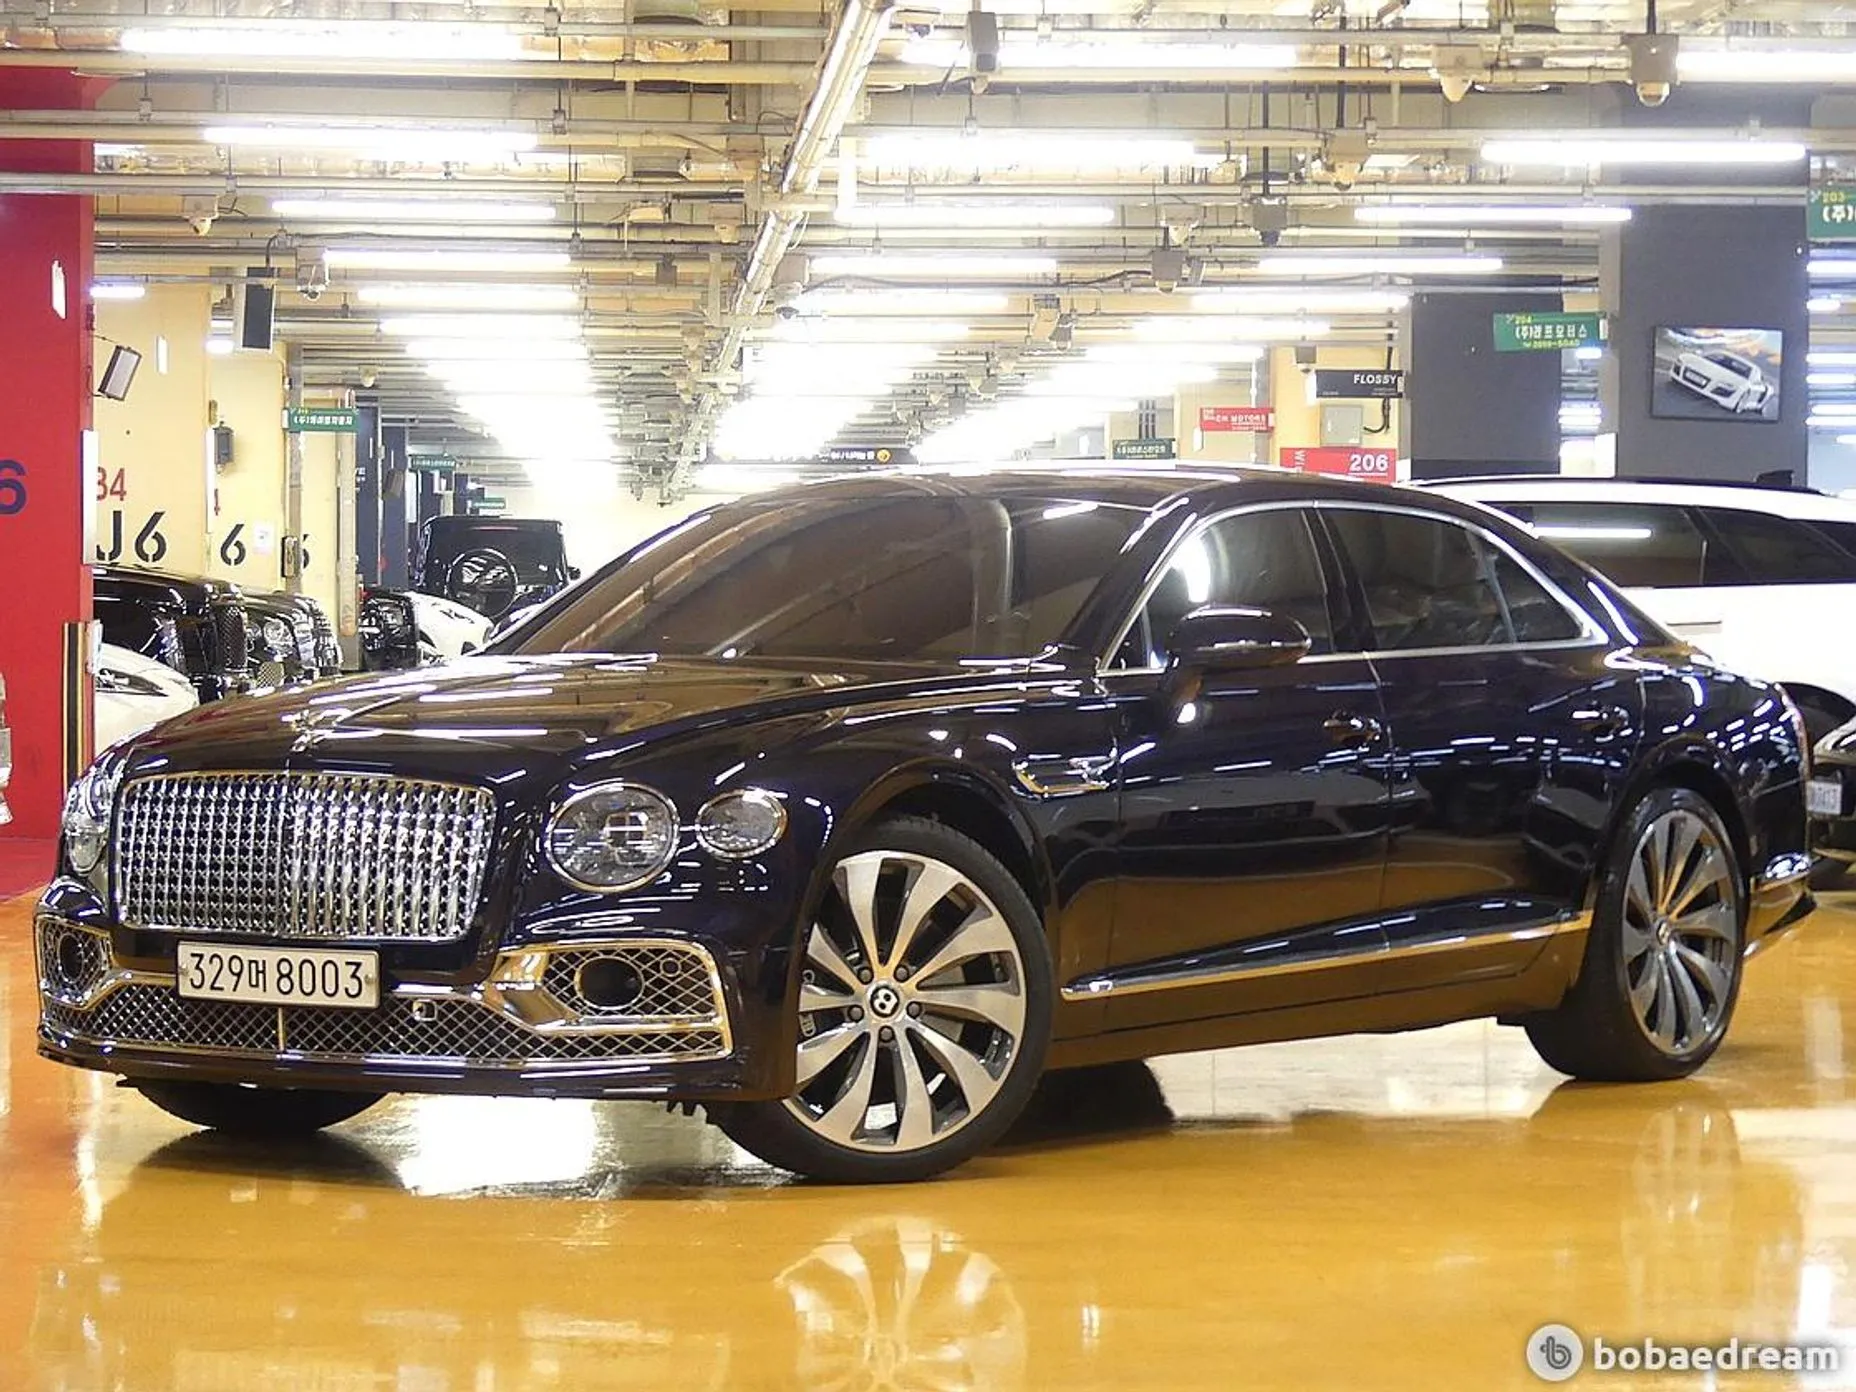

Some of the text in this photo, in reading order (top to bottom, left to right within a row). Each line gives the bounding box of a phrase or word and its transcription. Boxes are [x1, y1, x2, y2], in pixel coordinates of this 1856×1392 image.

[1823, 205, 1856, 222] (주)
[1354, 374, 1397, 385] FLOSSY
[1349, 454, 1389, 471] 206
[220, 524, 246, 567] 6
